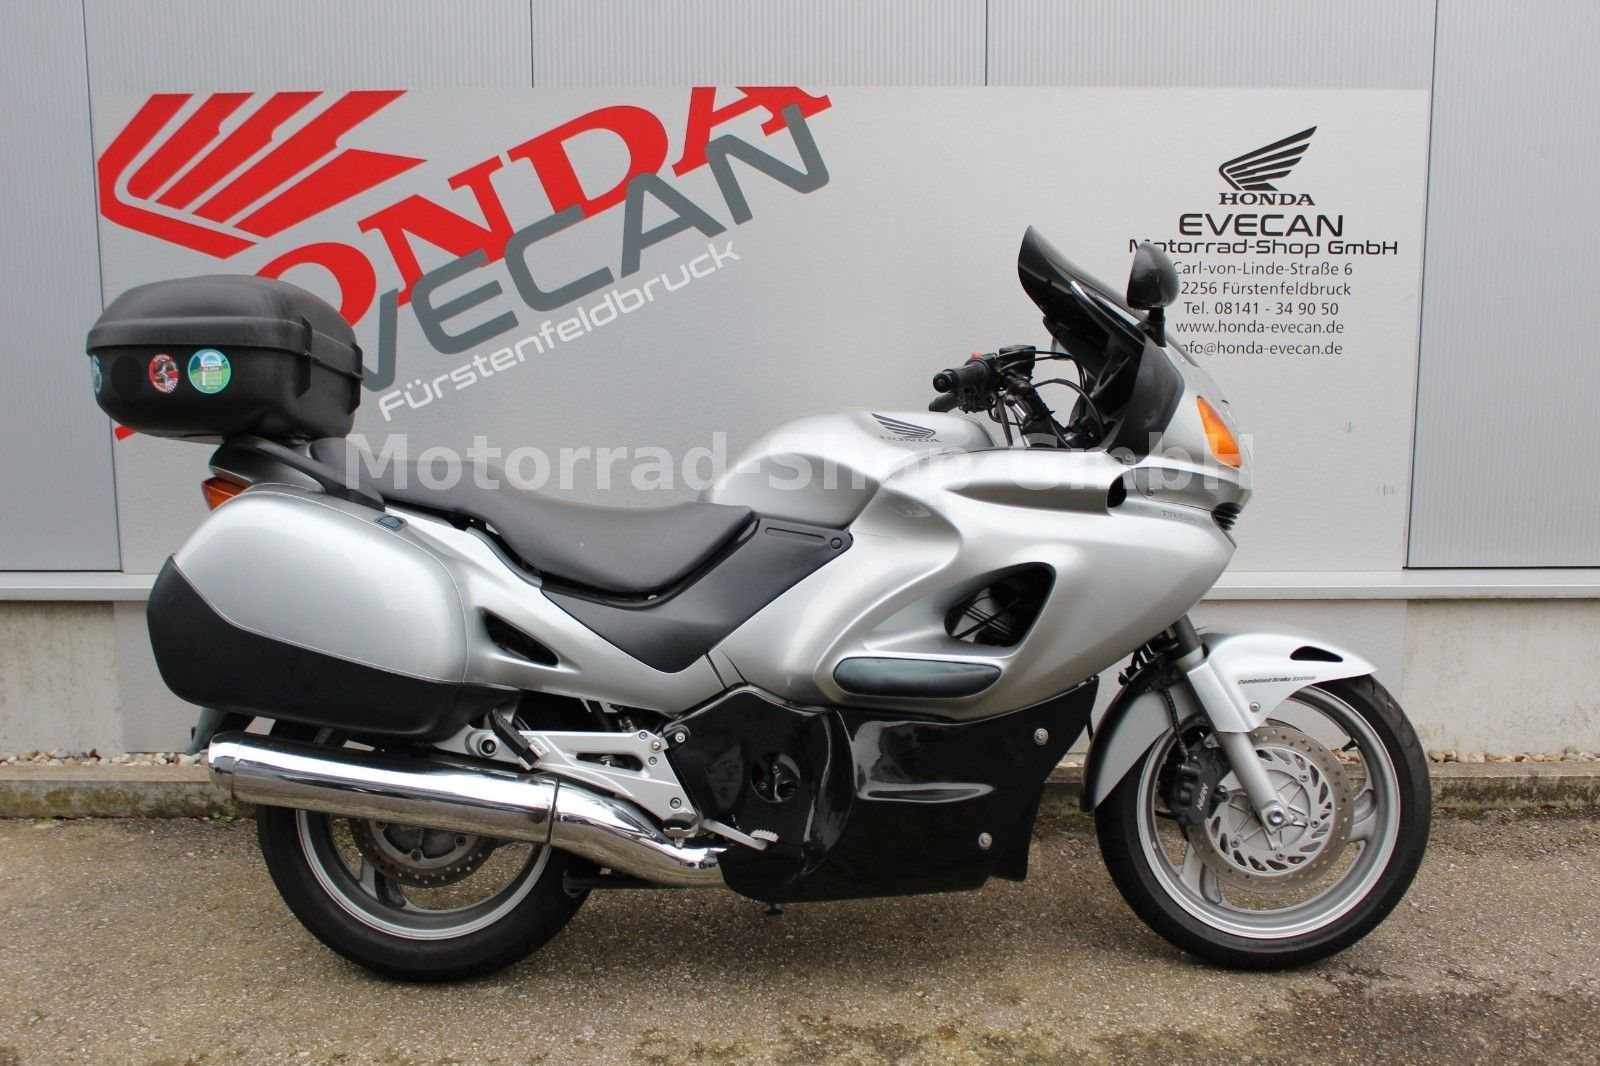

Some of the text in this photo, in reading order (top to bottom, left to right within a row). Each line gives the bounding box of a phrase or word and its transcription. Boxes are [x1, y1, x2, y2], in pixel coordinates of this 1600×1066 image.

[1218, 192, 1316, 206] HONDA
[254, 86, 832, 329] ONDA
[1178, 213, 1344, 237] EVECAN
[361, 103, 830, 392] VECAN
[1327, 239, 1398, 256] GmbH
[1344, 261, 1353, 276] 6
[1180, 281, 1352, 296] 2256 Fürstenfeldbruck
[1183, 301, 1209, 315] Tel.
[1214, 301, 1259, 315] 08141
[1275, 301, 1294, 315] 34
[1298, 301, 1316, 315] 90
[1321, 302, 1339, 316] 50
[377, 239, 741, 422] Fürstenfeldbruck
[1176, 319, 1344, 334] www.honda-evecan.de
[1183, 340, 1343, 356] nfo@honda-evecan.de
